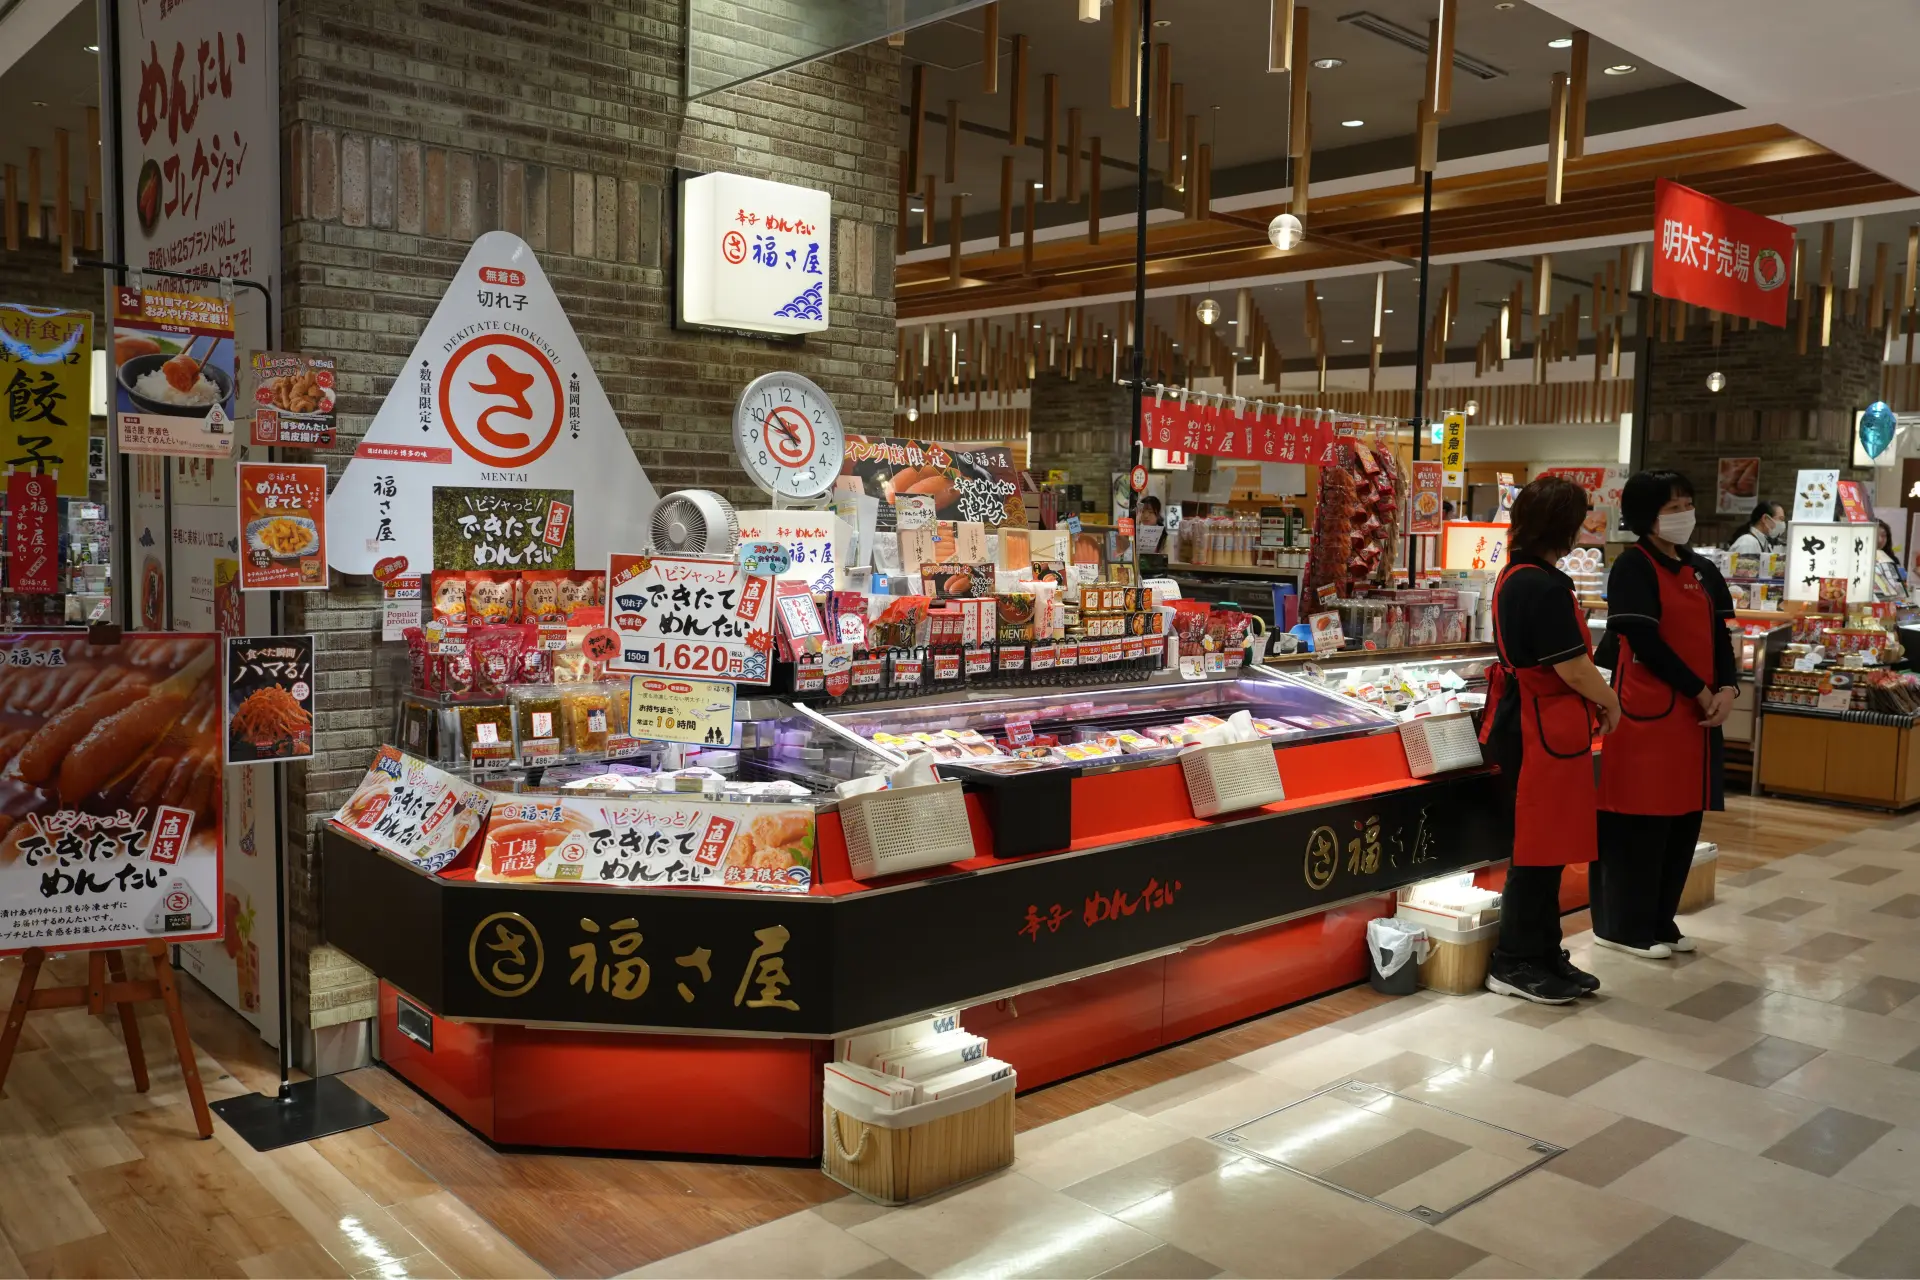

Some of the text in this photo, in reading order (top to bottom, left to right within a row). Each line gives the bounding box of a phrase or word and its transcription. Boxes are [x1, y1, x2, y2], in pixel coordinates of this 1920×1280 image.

[138, 31, 246, 147] めんたい
[164, 131, 248, 220] コレクション
[735, 209, 816, 236] 辛子 めんたい
[752, 234, 823, 275] 福さ屋
[1662, 218, 1750, 283] 明太子売場
[485, 269, 521, 285] 無着色
[121, 293, 139, 307] 3位
[476, 289, 529, 312] 切れ子
[145, 307, 230, 326] おみやげ決定戦!!
[443, 320, 562, 366] DEKITATE CHOKUSOU
[418, 368, 432, 425] 数量限定
[762, 393, 773, 408] 11
[780, 388, 792, 403] 12
[801, 393, 807, 409] 1
[568, 379, 581, 432] 福岡限定
[753, 407, 765, 422] 10
[4, 367, 68, 475] 餃子
[813, 409, 823, 425] 2
[124, 425, 170, 437] 福さ屋 無着色
[124, 434, 178, 446] 出来たてめんたい
[750, 429, 759, 444] 9
[822, 431, 831, 446] 3
[1184, 431, 1235, 453] 福さ屋
[1447, 422, 1460, 465] 宅急便
[400, 449, 428, 459] 博多の味
[758, 450, 768, 466] 8
[819, 453, 827, 467] 4
[975, 452, 1009, 468] 福さ屋
[1280, 442, 1334, 463] 福さ屋
[480, 471, 528, 482] MENTAI
[773, 466, 781, 481] 7
[808, 466, 817, 481] 5
[255, 481, 309, 495] めんたい
[953, 477, 1016, 495] 辛子めんたい
[373, 475, 397, 542] 福さ屋
[475, 495, 535, 513] ピシャっと
[958, 496, 1008, 525] 博多
[457, 515, 543, 539] できたて
[547, 507, 566, 544] 直送
[776, 528, 828, 539] 辛子 めんたい
[473, 543, 558, 566] めんたい
[753, 544, 779, 554] スタッフ
[789, 543, 834, 564] 福さ屋
[376, 559, 406, 578] 新発売!
[1802, 535, 1826, 587] やまや
[612, 558, 652, 587] 工場直送
[665, 566, 728, 585] ピシャっと
[442, 587, 466, 595] めんた
[478, 587, 508, 596] めんたい
[533, 587, 555, 595] めんたい
[561, 586, 590, 594] めんたい
[645, 584, 736, 611] できたて
[740, 581, 761, 617] 直送
[621, 598, 644, 609] 切れ子
[386, 617, 418, 626] product
[387, 611, 419, 619] Popular
[617, 616, 643, 628] 無着色
[659, 612, 751, 637] めんたい
[11, 648, 66, 666] 福さ屋
[246, 647, 297, 660] 食べた瞬間
[626, 652, 647, 663] 150g
[233, 661, 310, 684] ハマる!
[826, 674, 849, 686] 新発売
[639, 704, 674, 714] お持ち歩き
[636, 718, 654, 726] 常温で
[677, 720, 697, 731] 時間
[389, 786, 437, 821] できたて
[44, 809, 132, 832] ピシャっと
[520, 805, 564, 823] 福さ屋
[611, 810, 686, 827] ピシャっと
[154, 816, 182, 861] 直送
[374, 813, 422, 847] めんたい
[498, 838, 538, 859] 工場
[588, 828, 697, 858] できたて
[698, 822, 726, 863] 直送
[1347, 803, 1439, 876] 福さ屋
[18, 831, 148, 867] できたて
[500, 856, 537, 874] 直送
[599, 858, 711, 883] めんたい
[40, 863, 169, 898] めんたい
[724, 866, 789, 883] 数量限定
[1018, 876, 1183, 944] 辛子 めんたい
[13, 914, 114, 928] お届けするめんたいです。
[569, 916, 801, 1013] 福さ屋
